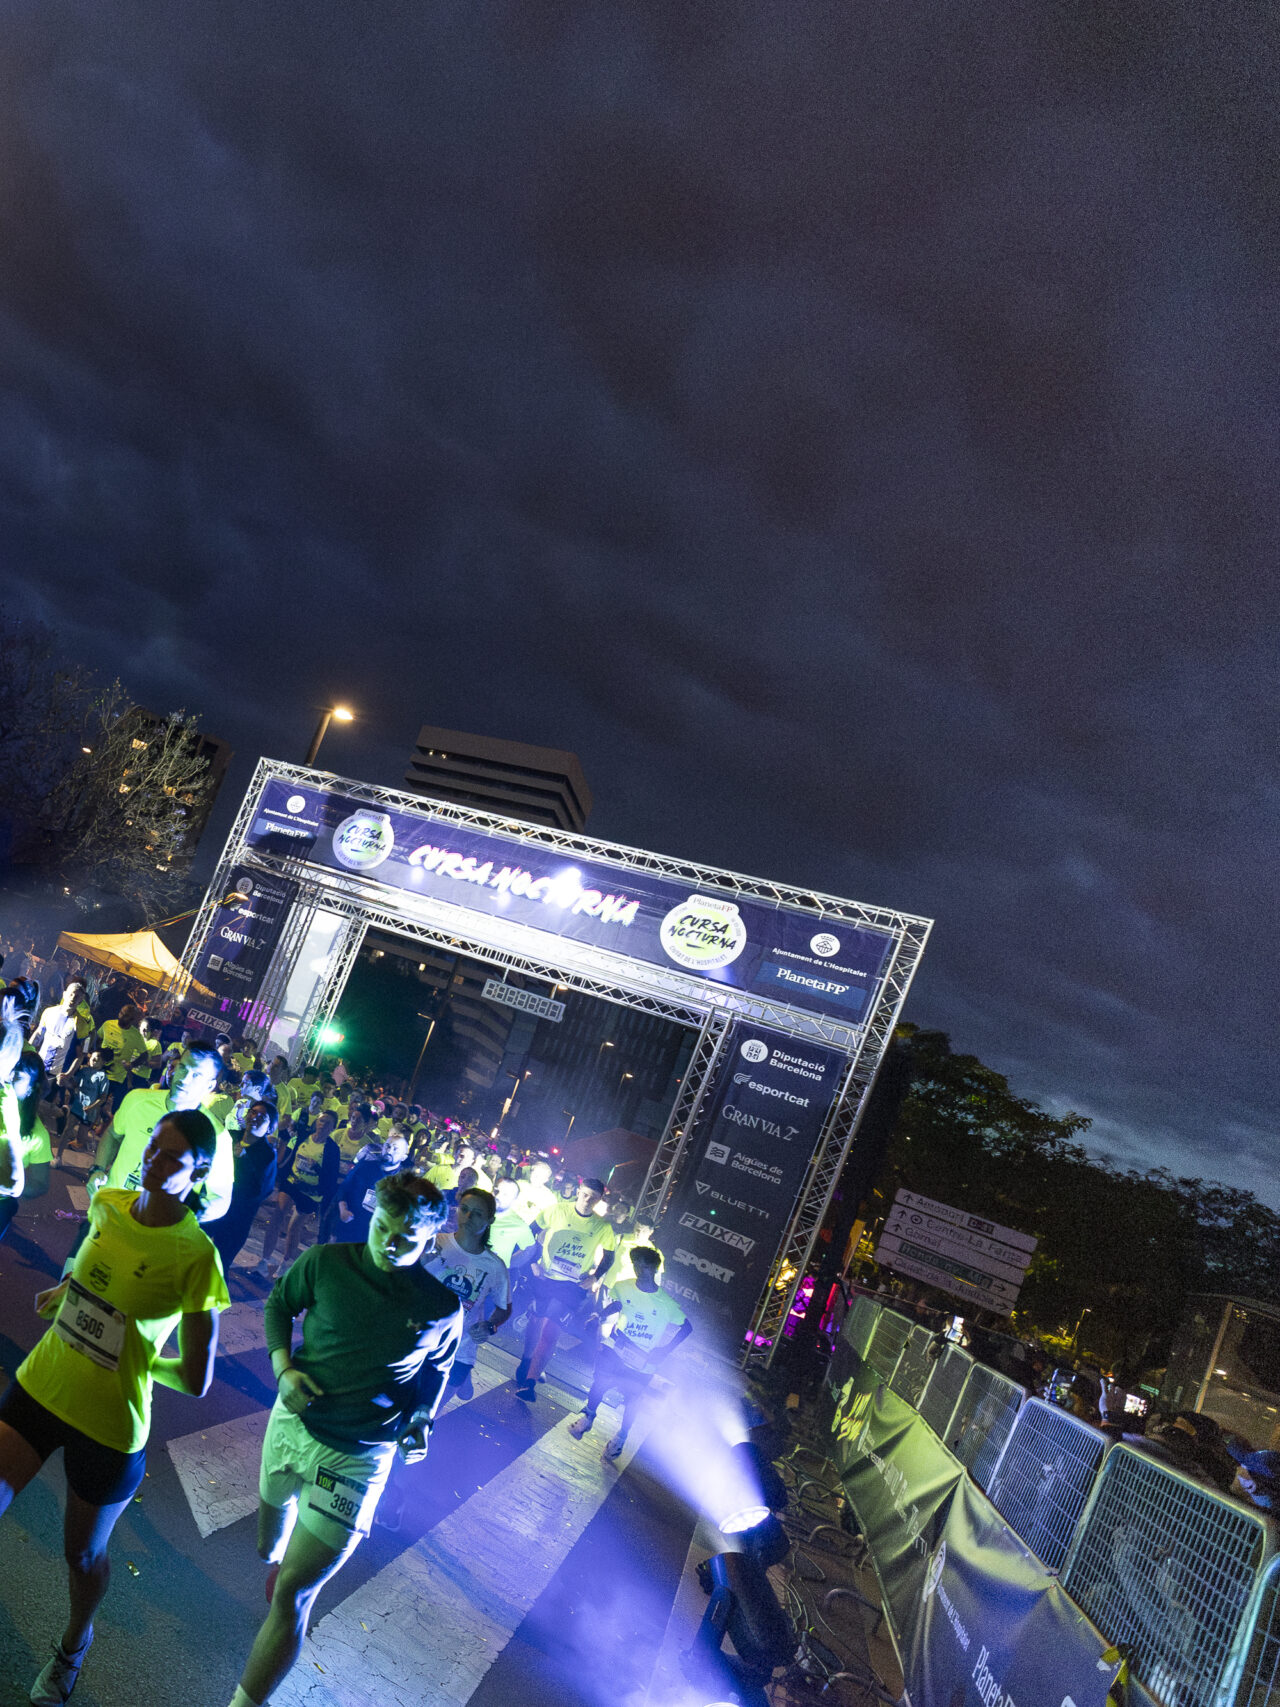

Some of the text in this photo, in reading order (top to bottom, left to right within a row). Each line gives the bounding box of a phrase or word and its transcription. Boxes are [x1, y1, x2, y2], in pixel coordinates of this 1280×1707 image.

[263, 808, 288, 820] Ajuntament
[338, 835, 386, 852] NOCTURNA
[347, 825, 383, 841] CURSA
[408, 844, 495, 885] CURSA
[680, 914, 729, 935] CURSA
[668, 925, 737, 950] NOCTURNA
[772, 947, 813, 963] Ajuntament
[824, 961, 867, 978] L'Hospitalet
[769, 1058, 822, 1081] Barcelona
[772, 1049, 826, 1073] Diputació
[748, 1081, 810, 1108] esportcat
[722, 1104, 760, 1129] GRAN
[759, 1119, 781, 1138] VIA
[731, 1160, 782, 1185] Barcelona
[733, 1152, 783, 1176] Aigües de
[710, 1190, 770, 1219] BLUETTI
[672, 1248, 735, 1283] SPORT
[317, 1475, 334, 1491] 10K
[330, 1493, 360, 1529] 3897
